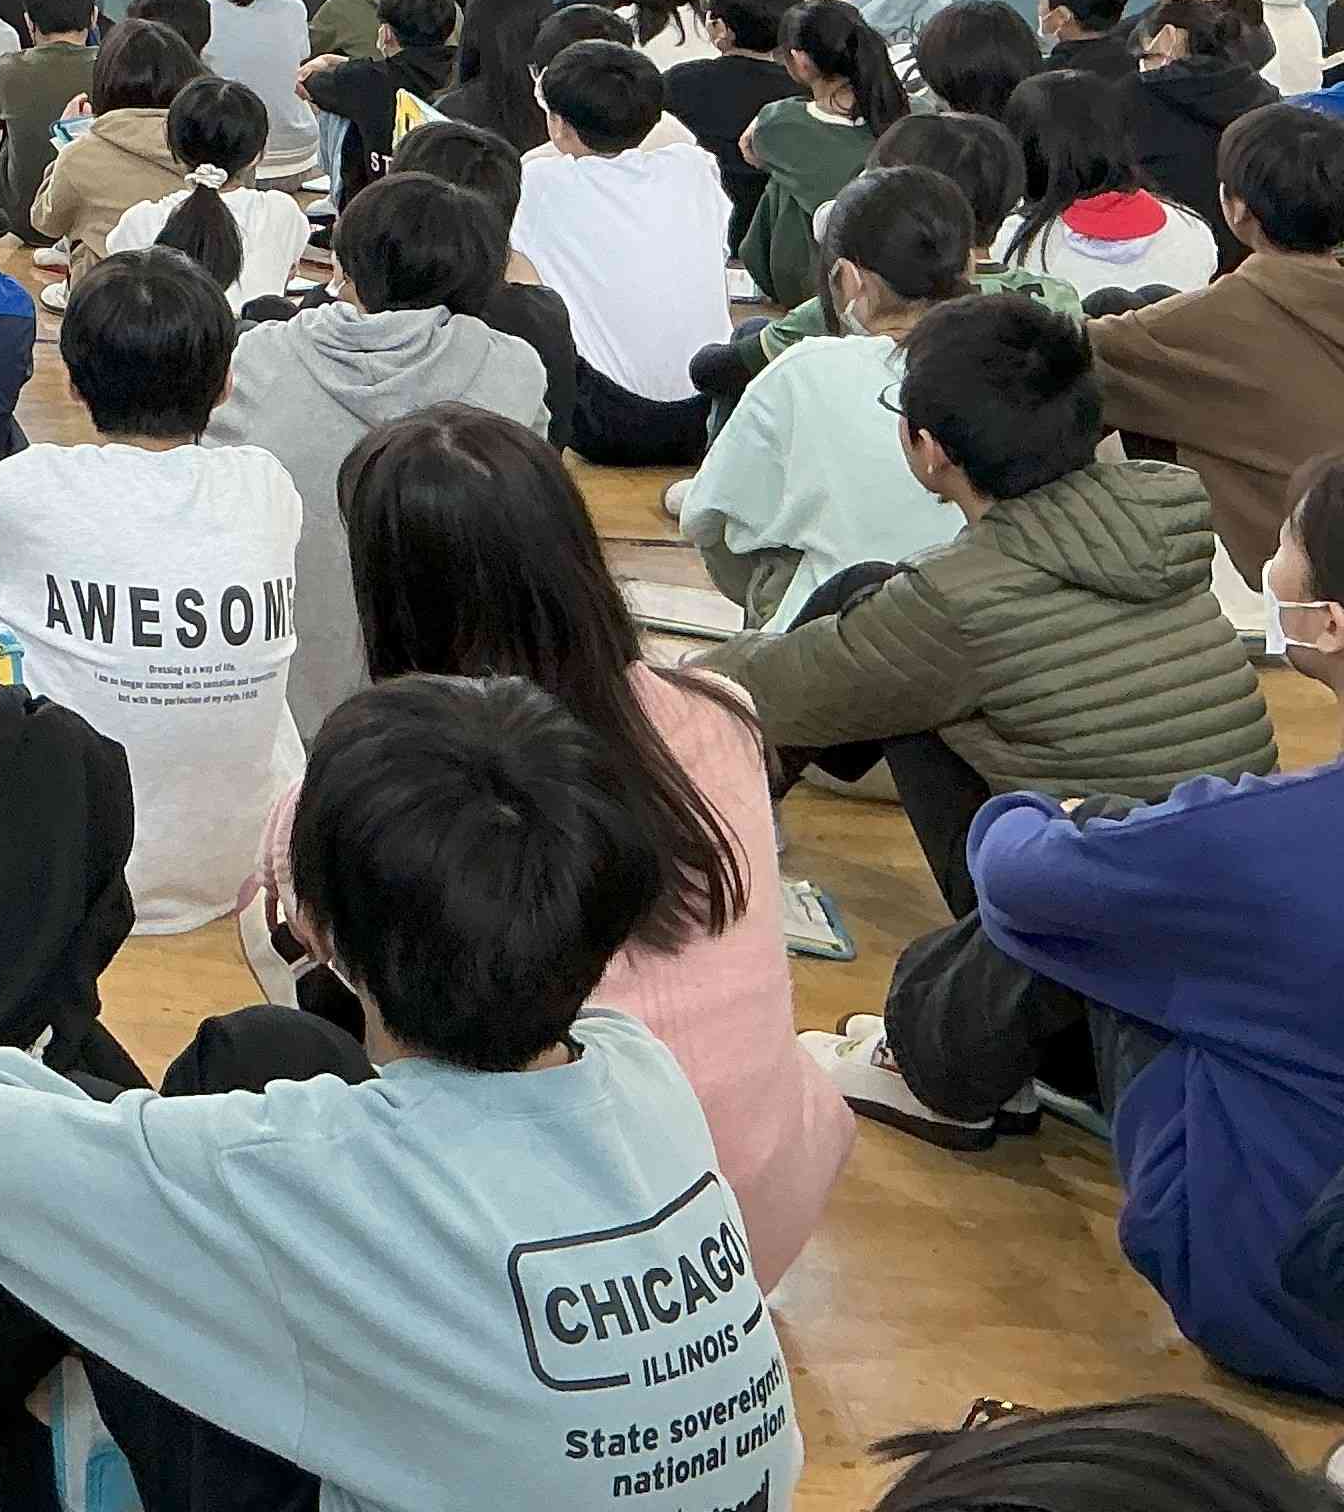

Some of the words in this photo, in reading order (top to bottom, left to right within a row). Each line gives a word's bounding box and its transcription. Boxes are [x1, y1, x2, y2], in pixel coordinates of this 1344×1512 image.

[544, 1221, 746, 1345] CHICAGO
[641, 1324, 739, 1387] ILLINOIS
[564, 1423, 660, 1460] State
[612, 1436, 727, 1497] national
[736, 1404, 786, 1458] union
